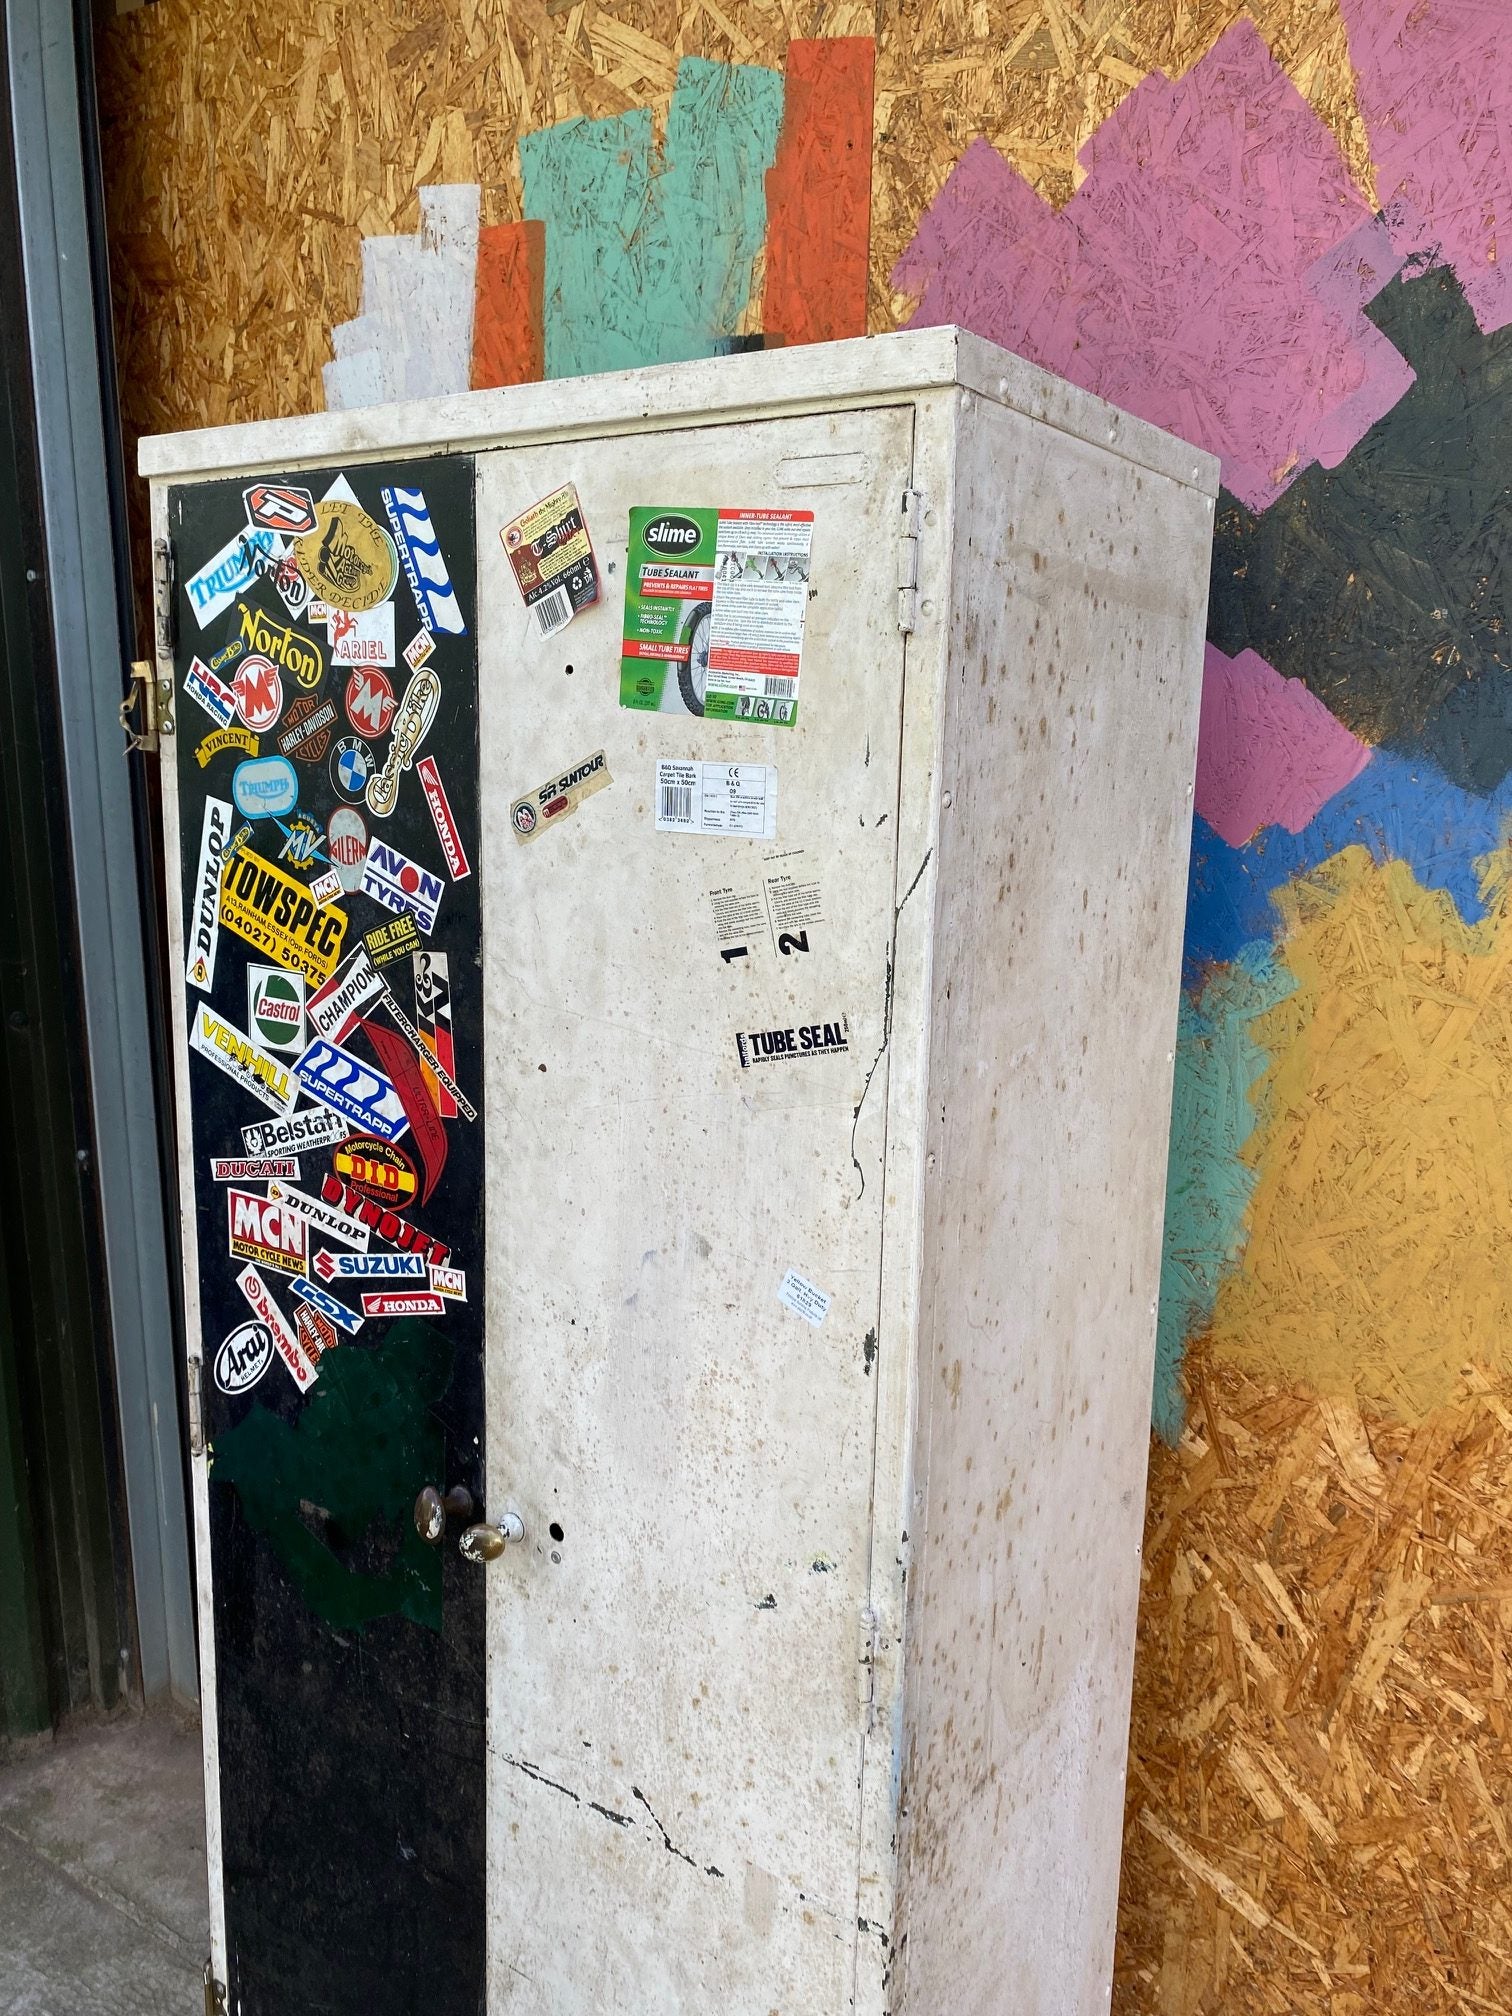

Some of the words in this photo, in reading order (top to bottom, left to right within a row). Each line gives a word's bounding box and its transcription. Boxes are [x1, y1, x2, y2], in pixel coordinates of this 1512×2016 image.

[321, 502, 352, 515] LET
[358, 513, 383, 548] THE
[648, 521, 697, 543] slime
[381, 488, 433, 631] SUPERTRAPP
[642, 567, 663, 577] TUBE
[664, 568, 699, 579] SEALANT
[330, 577, 386, 610] DECIDE
[238, 603, 323, 689] Norton
[341, 640, 387, 659] ARIEL
[405, 633, 431, 663] MCN
[639, 643, 657, 651] SMALL
[658, 645, 673, 653] TUBE
[673, 646, 689, 654] TIRES
[186, 683, 206, 706] HONDA
[206, 703, 228, 726] RACING
[287, 700, 316, 725] MOTOR
[205, 733, 249, 753] VINCENT
[280, 704, 335, 752] HARLEY-DAVIDSON
[297, 732, 328, 758] CYCLES
[337, 739, 375, 768] BMW
[239, 778, 290, 798] TRIUMPH
[539, 784, 557, 805] SR
[559, 755, 604, 792] SUNTOUR
[428, 789, 461, 874] HONDA
[331, 835, 367, 865] GILERA
[197, 806, 225, 957] DUNLOP
[314, 873, 340, 901] MCN
[369, 845, 442, 903] AVON
[224, 854, 343, 958] TOWSPEC
[221, 904, 276, 953] (04027)
[281, 948, 328, 987] 50375
[366, 927, 390, 950] RIDE
[389, 915, 416, 939] FREE
[778, 930, 810, 956] 2
[393, 946, 406, 957] YOU
[720, 946, 748, 964] 1
[258, 998, 301, 1022] Castrol
[319, 963, 376, 1032] CHAMPION
[749, 1029, 798, 1056] TUBE
[799, 1022, 848, 1050] SEAL
[784, 1051, 811, 1060] PUNCTURES
[830, 1046, 849, 1054] HAPPEN
[203, 1011, 291, 1101] VENHILL
[382, 995, 439, 1071] FILTERCHARGER
[437, 1070, 476, 1118] EQUIPPED
[201, 1044, 240, 1081] PROFESSIONAL
[240, 1074, 270, 1101] PRODUCTS
[300, 1070, 393, 1136] SUPERTRAPP
[267, 1145, 296, 1158] SPORTING
[296, 1131, 347, 1150] WEATHERPRFS
[345, 1141, 383, 1155] Motorcycle
[385, 1147, 406, 1170] Chain
[216, 1161, 295, 1178] DUCATI
[350, 1181, 399, 1202] Professional
[233, 1196, 303, 1256] MCN
[285, 1194, 367, 1240] DUNLOP
[322, 1175, 450, 1267] DYNOJET
[233, 1240, 260, 1257] MOTOR
[260, 1249, 281, 1264] CYCLE
[282, 1256, 304, 1271] NEWS
[338, 1256, 423, 1275] SUZUKI
[433, 1270, 462, 1290] MCN
[383, 1299, 441, 1313] HONDA
[256, 1296, 307, 1382] brembo
[225, 1324, 266, 1389] Arai
